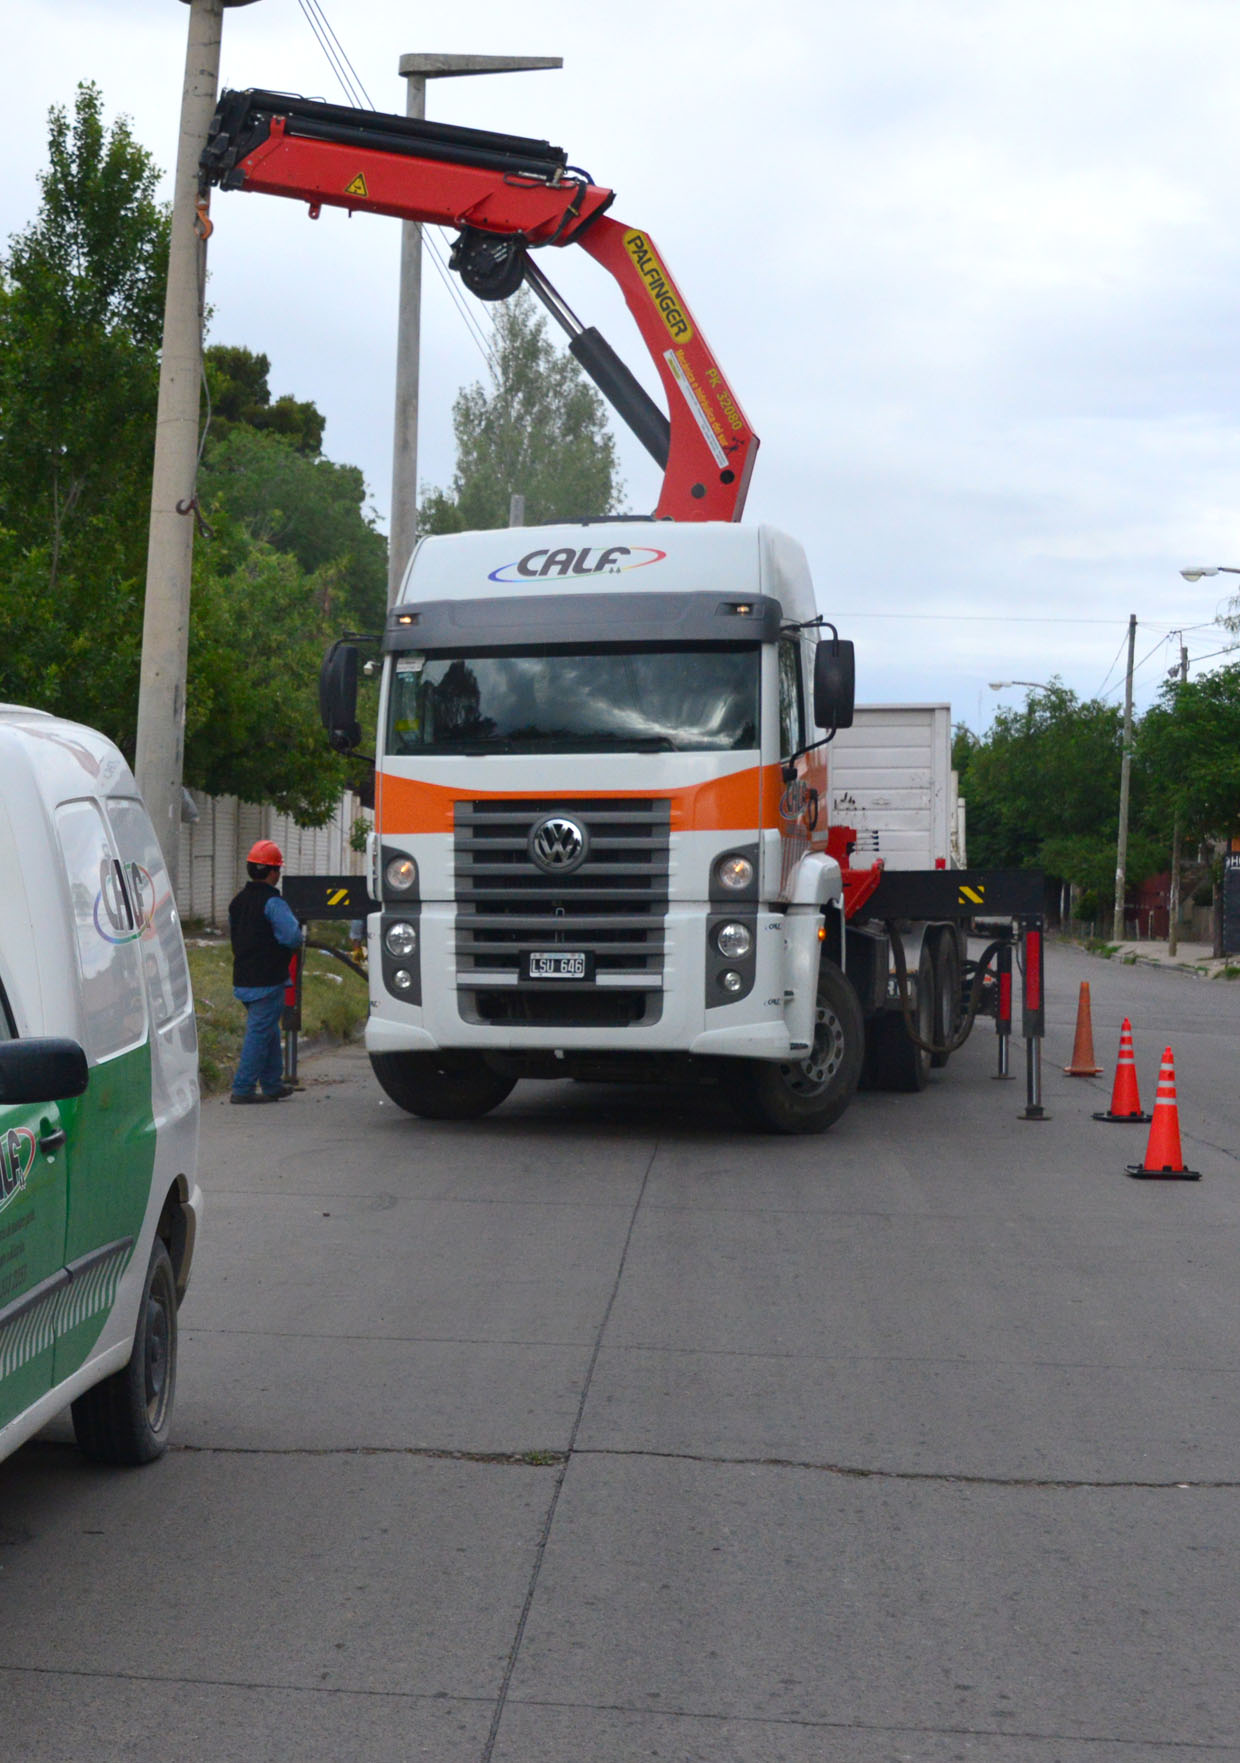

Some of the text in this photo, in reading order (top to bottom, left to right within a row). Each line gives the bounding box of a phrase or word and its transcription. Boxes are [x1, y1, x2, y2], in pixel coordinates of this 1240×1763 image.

[627, 235, 688, 337] PALFINGER
[706, 367, 722, 388] PK
[532, 959, 582, 973] LSU 646
